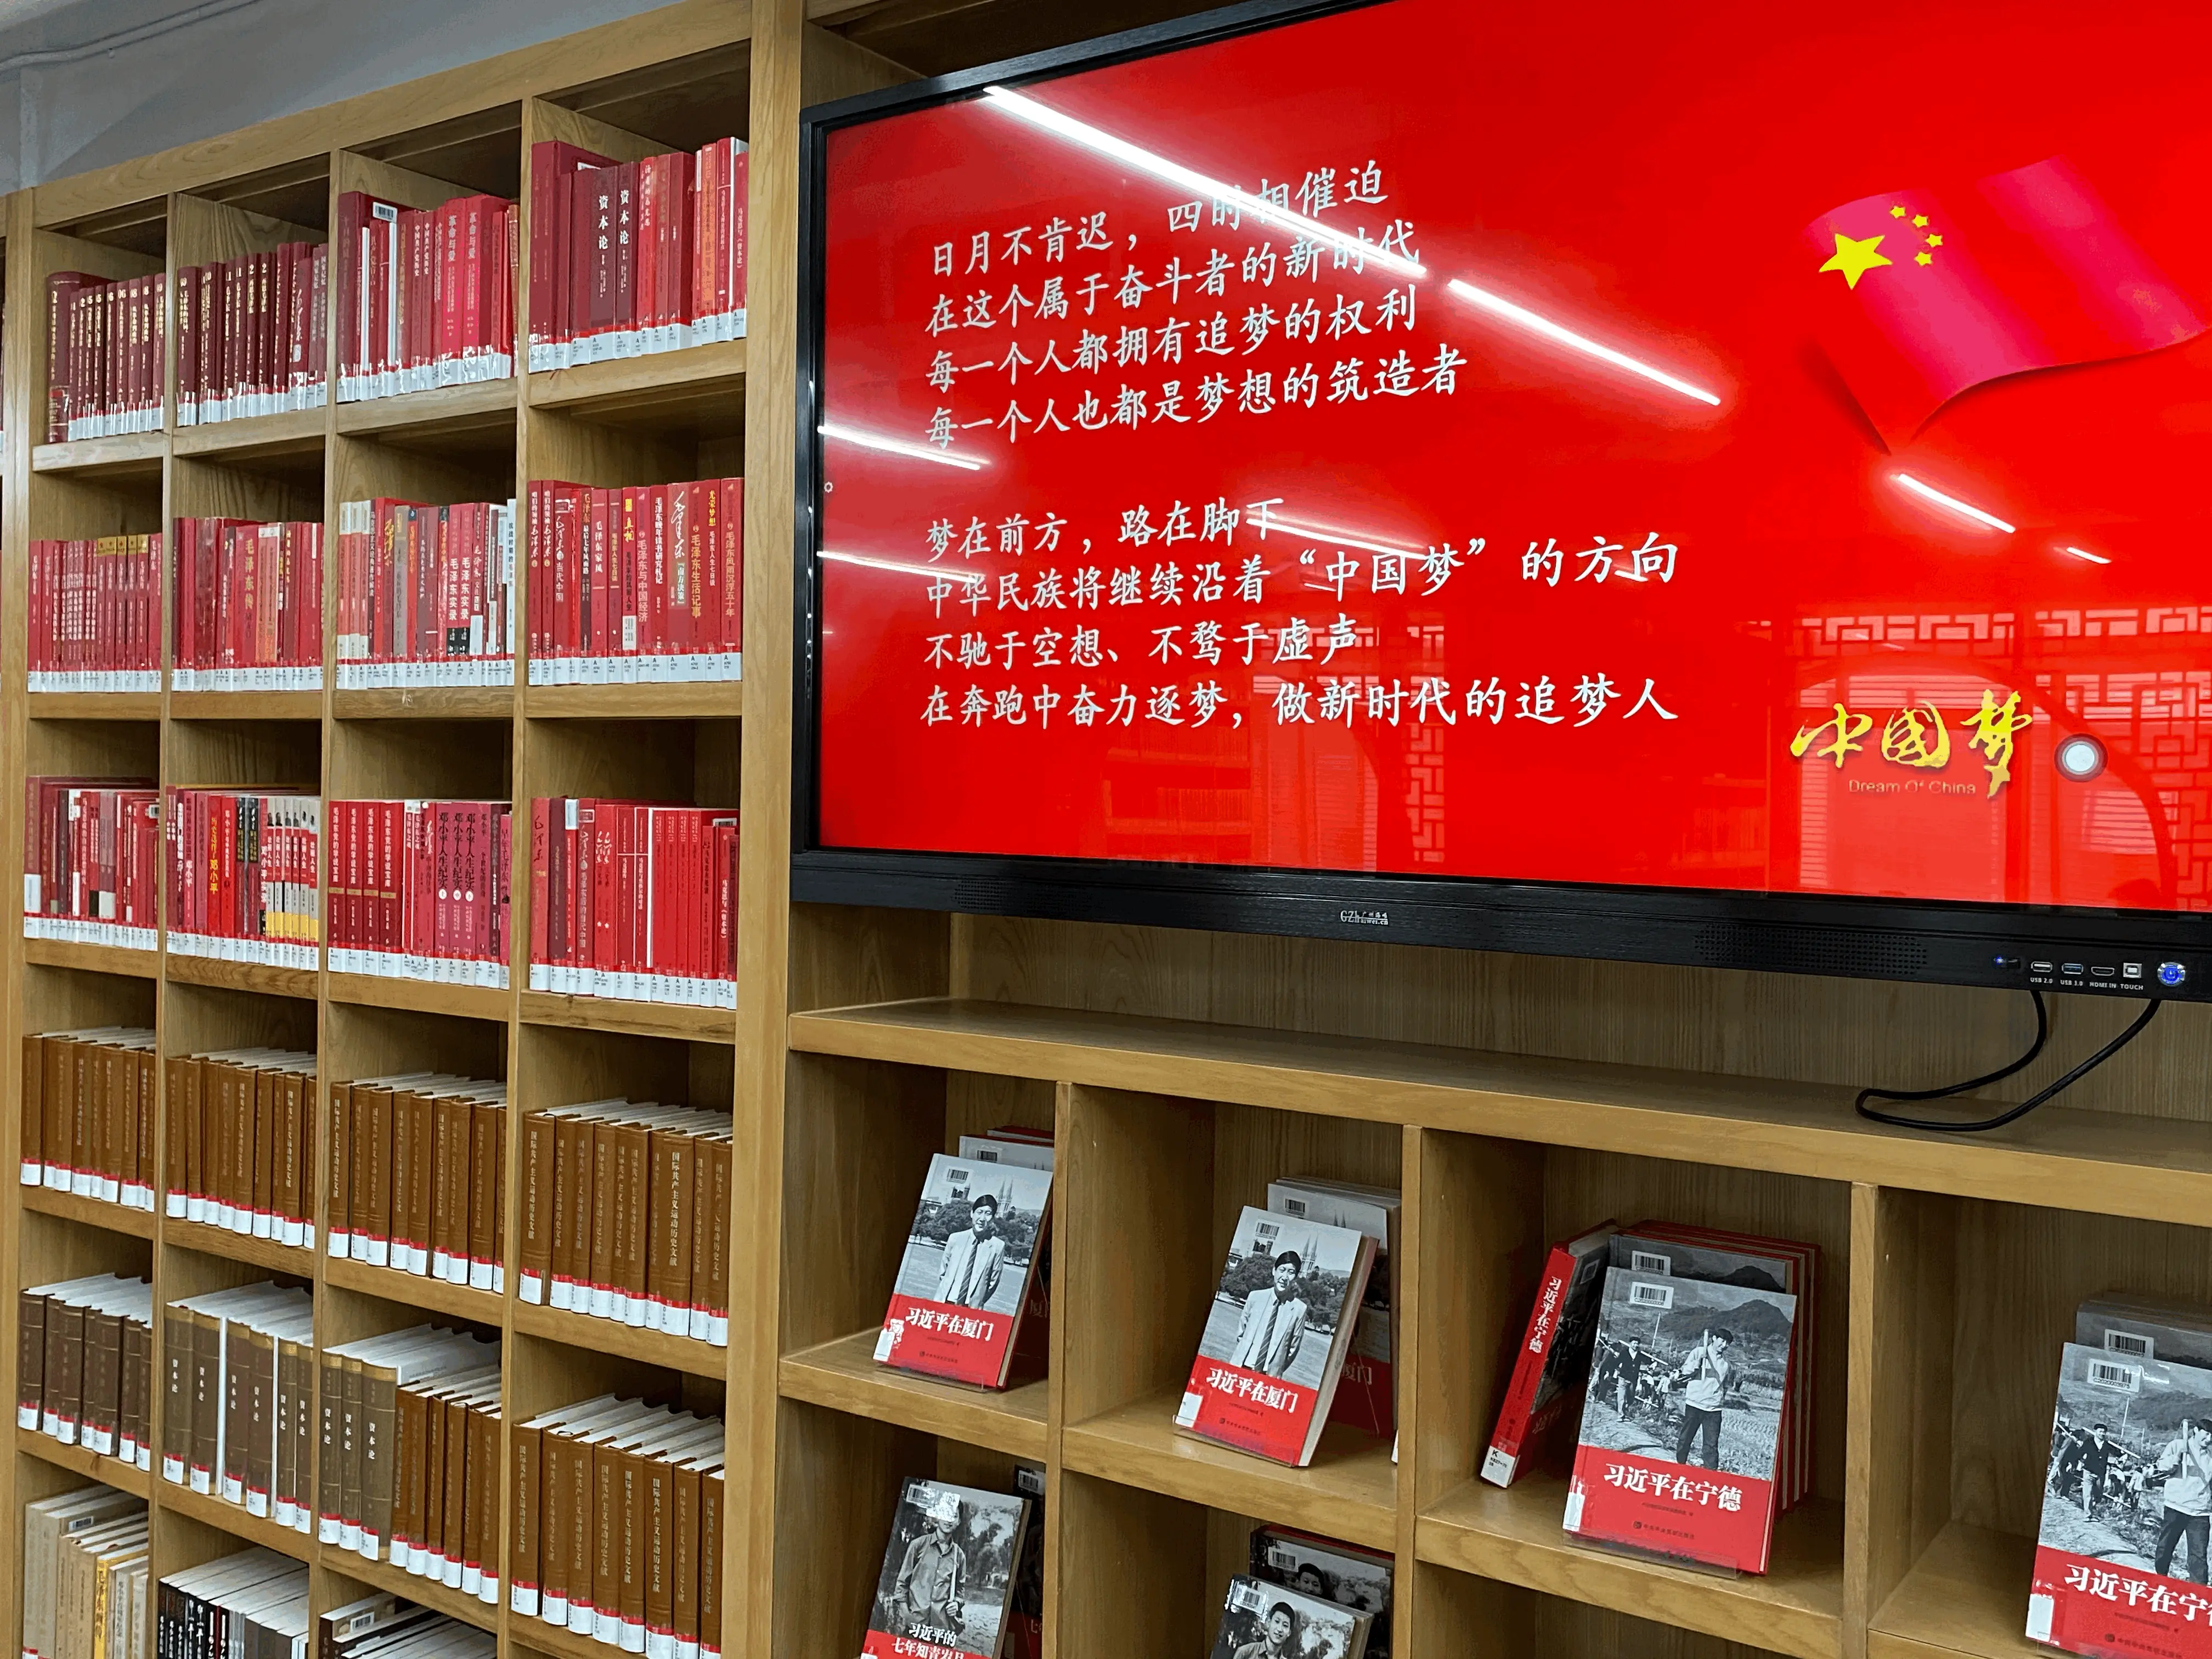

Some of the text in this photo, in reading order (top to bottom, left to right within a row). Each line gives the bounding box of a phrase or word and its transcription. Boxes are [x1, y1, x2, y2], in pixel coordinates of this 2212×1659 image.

[599, 195, 608, 250] 资本论
[619, 190, 629, 245] 资本论
[925, 219, 1421, 337] 在这个属于奋斗者的新时代
[925, 283, 1416, 393] 每一个人都拥有追梦的权利
[925, 342, 1468, 449] 每一个人也都是梦想的筑造者
[595, 521, 603, 573] 毛泽东家风
[926, 496, 1284, 562] 梦在前方，路在脚下
[449, 557, 459, 621] 毛泽东实录
[460, 557, 470, 620] 毛泽东实录
[637, 540, 648, 622] 毛泽东与中国经济
[691, 535, 701, 619] 毛泽东生活记事
[725, 531, 735, 617] 毛泽东风雨沉浮五十年
[927, 532, 1678, 619] 中华民族将继续沿着“中国梦”的方向
[923, 612, 1357, 672] 不驰于空想、不骛于虚声
[921, 673, 1679, 730] 在奔跑中奋力逐梦，做新时代的追梦人
[1849, 779, 1900, 793] Dream
[1928, 780, 1976, 794] China
[669, 1152, 680, 1267] 国际共产主义运动历史文献
[905, 1307, 994, 1341] 习近平在厦门
[1528, 1277, 1562, 1353] 习近平在宁德
[1206, 1367, 1299, 1413] 习近平在厦门
[1604, 1463, 1742, 1512] 习近平在宁德
[909, 1622, 957, 1647] 习近平的
